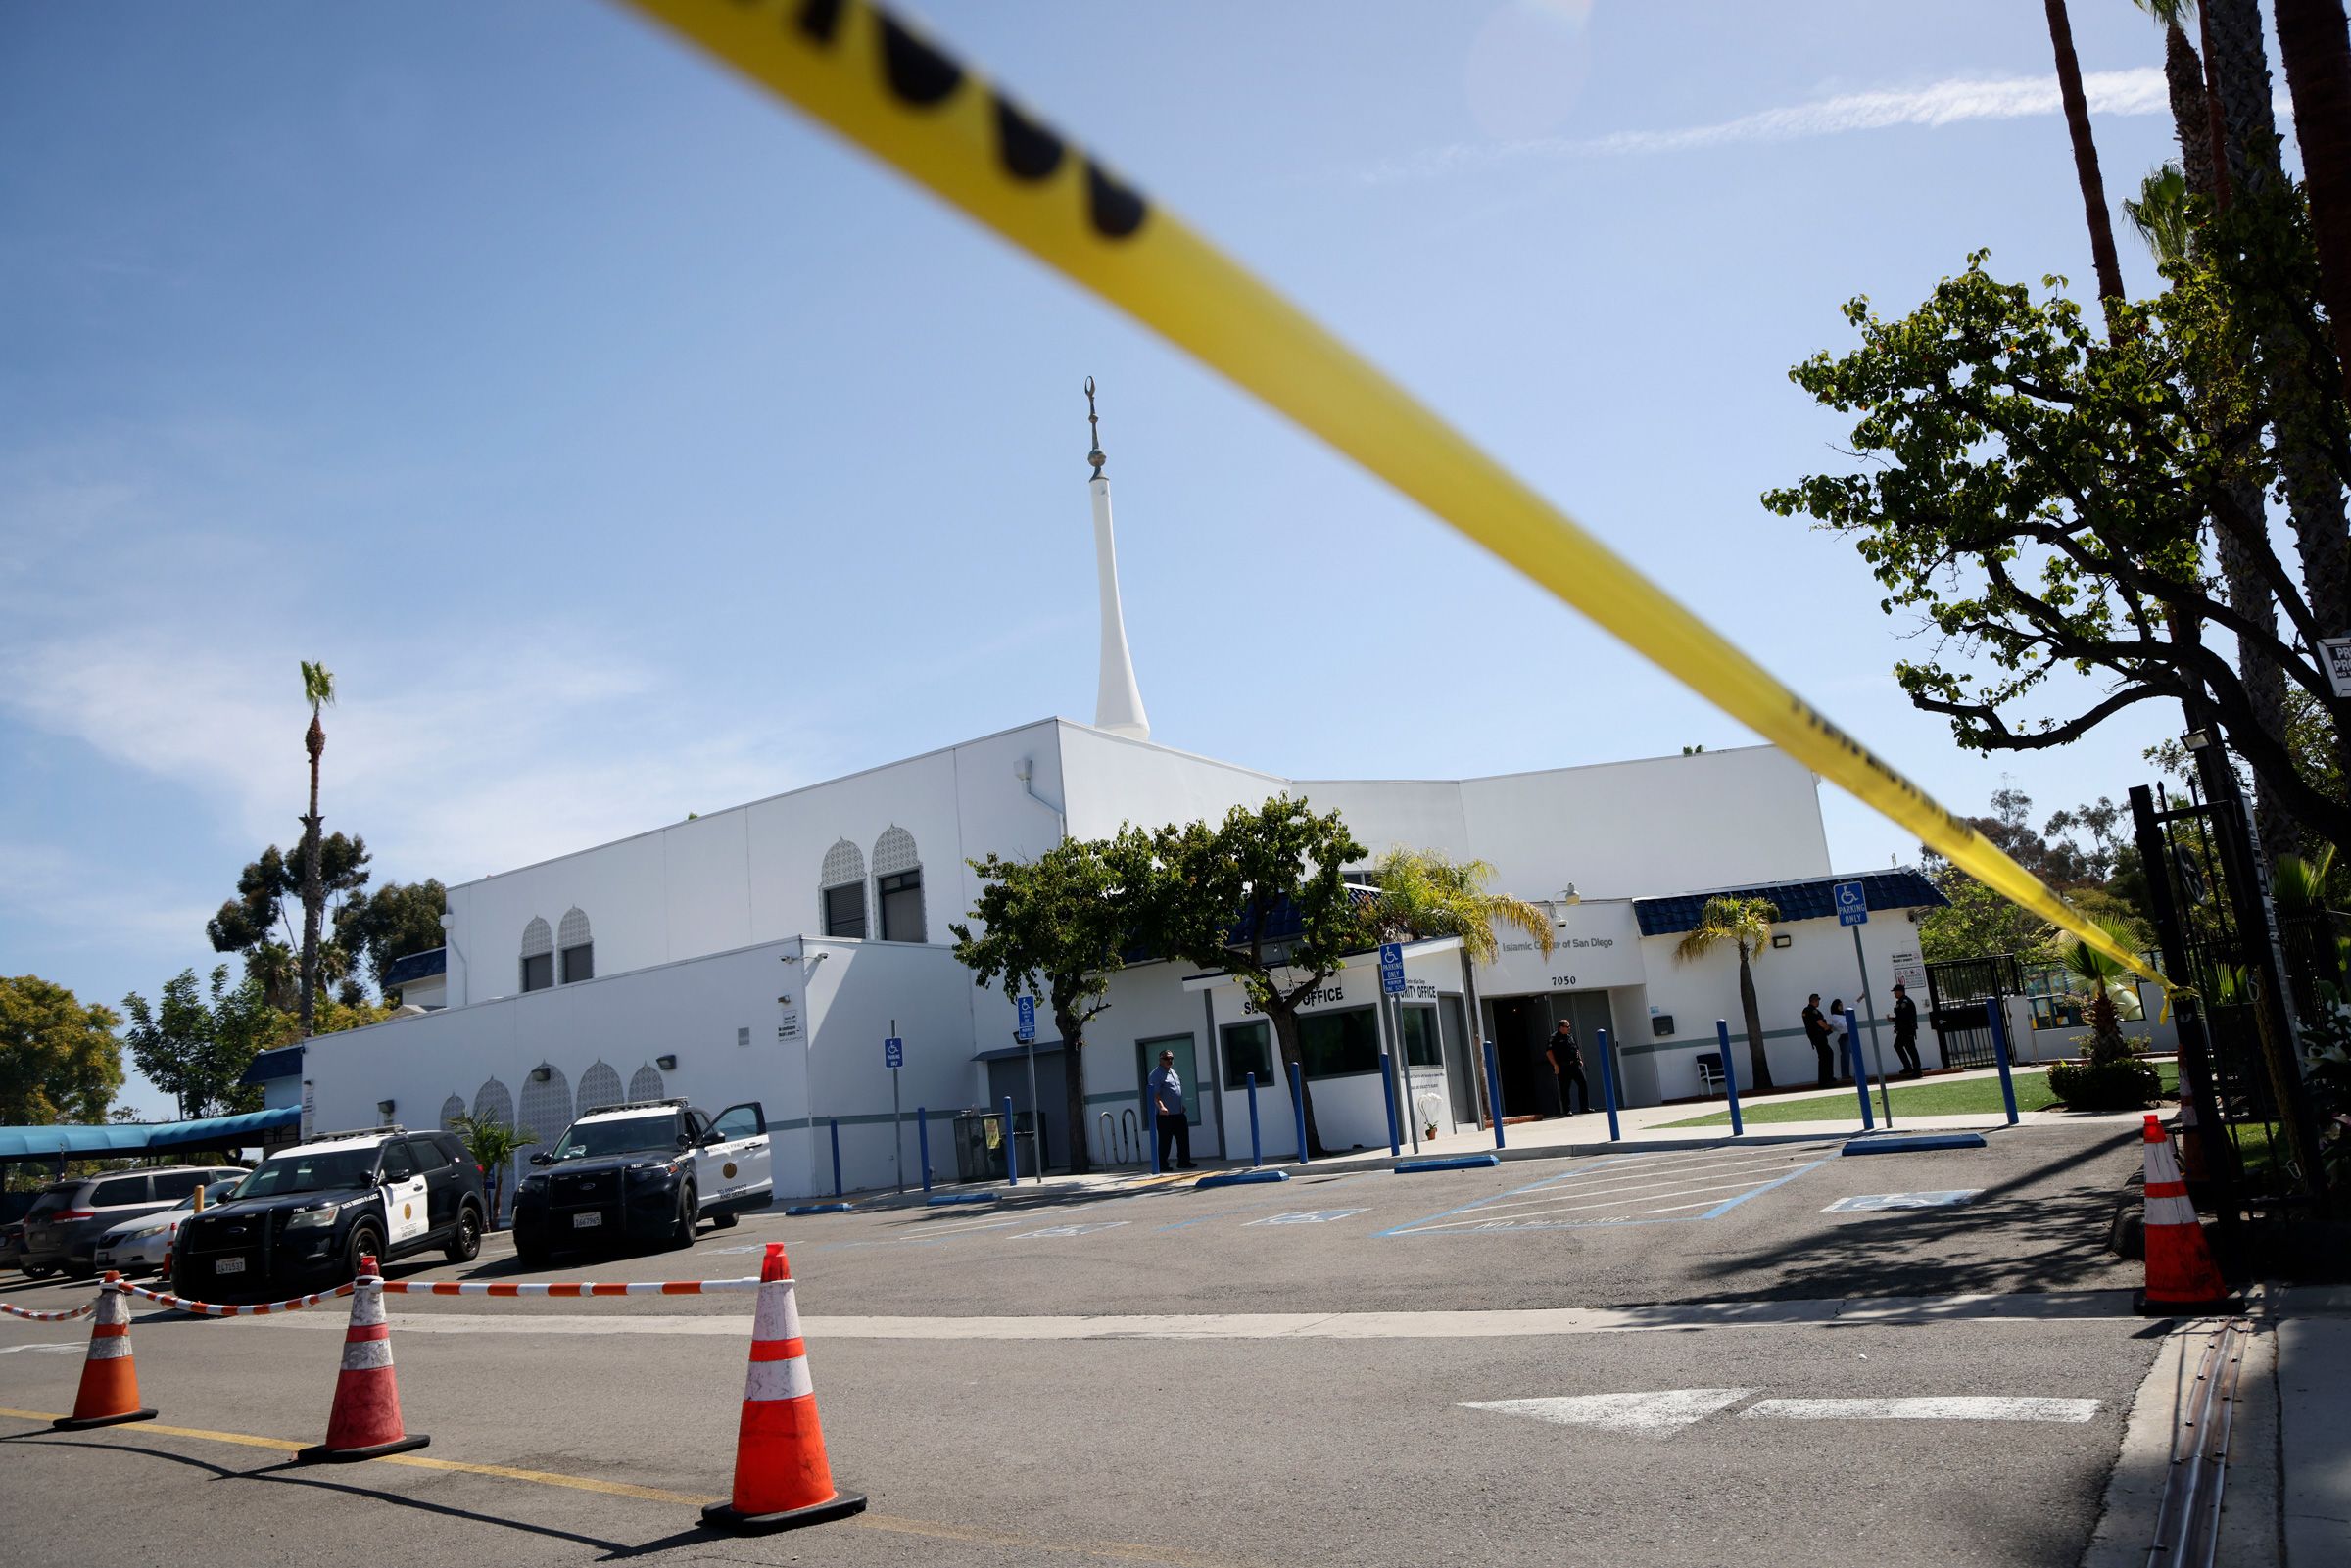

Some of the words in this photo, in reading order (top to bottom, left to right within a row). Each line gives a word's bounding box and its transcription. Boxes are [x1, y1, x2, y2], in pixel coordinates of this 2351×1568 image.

[1838, 903, 1865, 915] PARKING
[1845, 914, 1861, 924] ONLY
[1503, 941, 1533, 952] Islamic
[1562, 939, 1570, 948] of
[1572, 938, 1589, 948] San
[1591, 937, 1613, 949] Diego
[1382, 962, 1403, 971] PARKING
[1552, 976, 1576, 986] 7050
[1303, 987, 1343, 1006] OFFICE
[1417, 985, 1436, 999] OFFICE
[731, 1189, 746, 1198] SERVE
